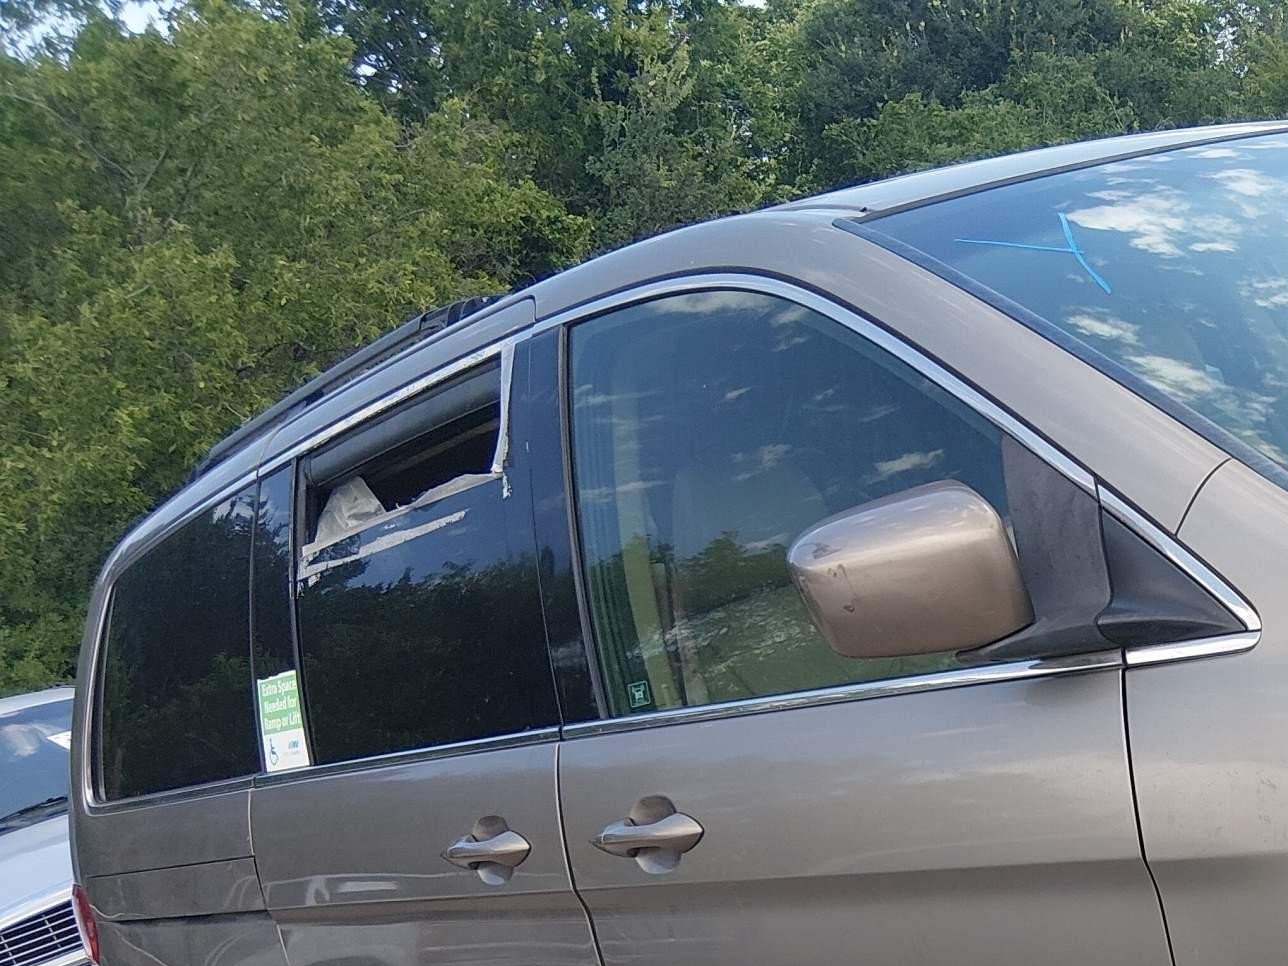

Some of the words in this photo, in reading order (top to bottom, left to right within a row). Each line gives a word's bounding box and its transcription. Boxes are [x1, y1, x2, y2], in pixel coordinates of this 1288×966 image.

[261, 683, 278, 697] Extra
[277, 679, 297, 696] Space
[264, 696, 287, 714] Needed
[286, 695, 297, 709] for
[264, 717, 282, 732] Ramp
[281, 716, 290, 728] or
